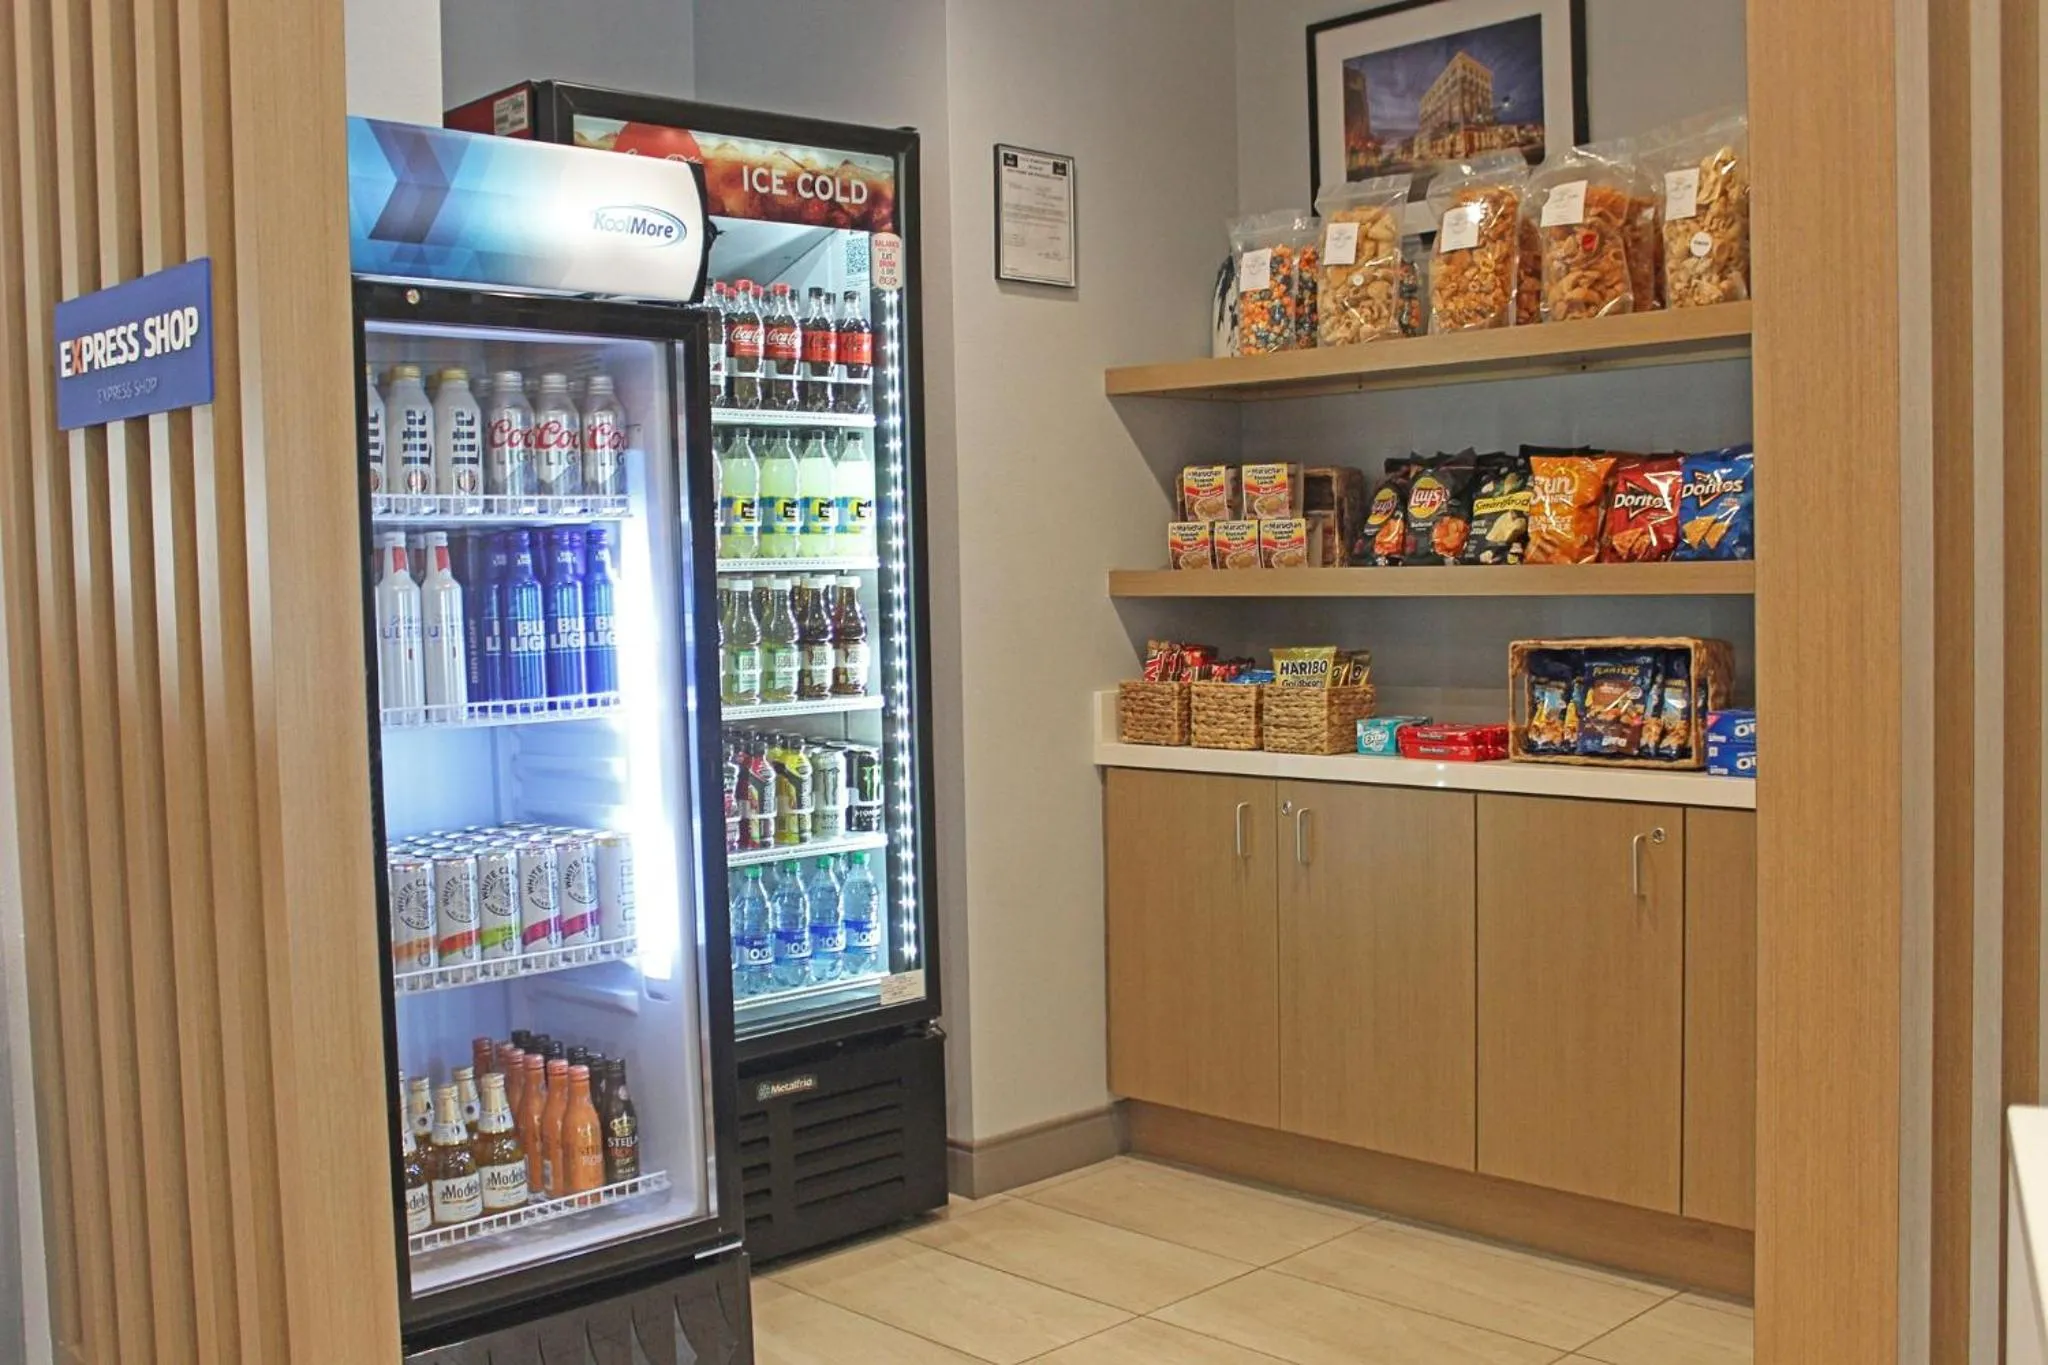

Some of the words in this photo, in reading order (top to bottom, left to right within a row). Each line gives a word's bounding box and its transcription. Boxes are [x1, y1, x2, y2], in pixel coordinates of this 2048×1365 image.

[742, 164, 788, 196] ICE
[796, 171, 869, 205] COLD
[593, 212, 674, 239] KoolMore
[60, 321, 139, 378] EXPRESS
[143, 306, 200, 358] SHOP
[401, 409, 431, 466] Lite
[452, 410, 480, 466] Lite
[1614, 494, 1673, 509] Doritos
[1682, 479, 1744, 498] Doritos
[1280, 660, 1328, 676] HARIBO
[481, 870, 498, 900] WHITE
[527, 864, 543, 895] WHITE
